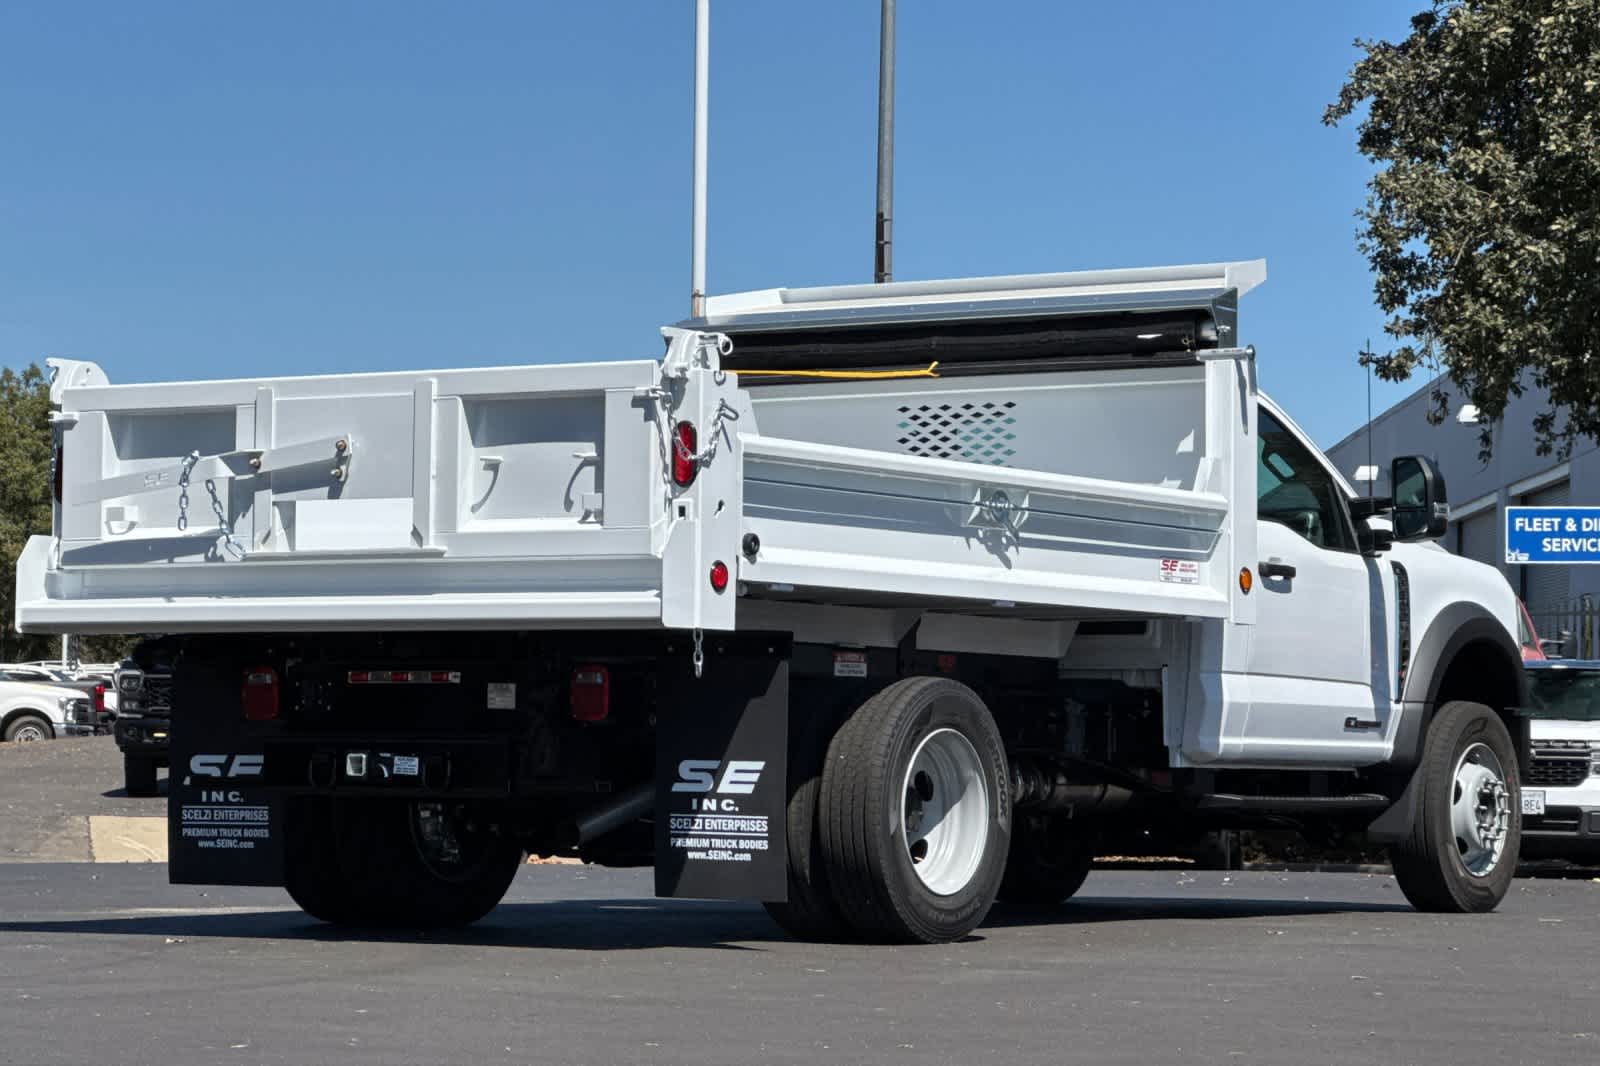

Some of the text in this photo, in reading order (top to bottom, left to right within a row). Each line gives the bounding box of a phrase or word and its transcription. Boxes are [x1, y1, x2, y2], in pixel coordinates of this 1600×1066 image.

[1514, 517, 1600, 532] FLEET & DI
[1542, 537, 1600, 552] SERVIC
[1161, 559, 1178, 571] SE
[671, 760, 766, 794] SE
[201, 790, 244, 803] INC.
[691, 798, 739, 811] INC.
[181, 809, 269, 821] SCELZI ENTERPRISES
[669, 817, 769, 832] SCELZI ENTERPRISES
[181, 827, 270, 838] PREMIUM TRUCK BODIES
[198, 839, 255, 849] www.SEINC.com
[670, 836, 769, 850] PREMIUM TRUCK BODIES
[687, 850, 752, 861] www.SEINC.com
